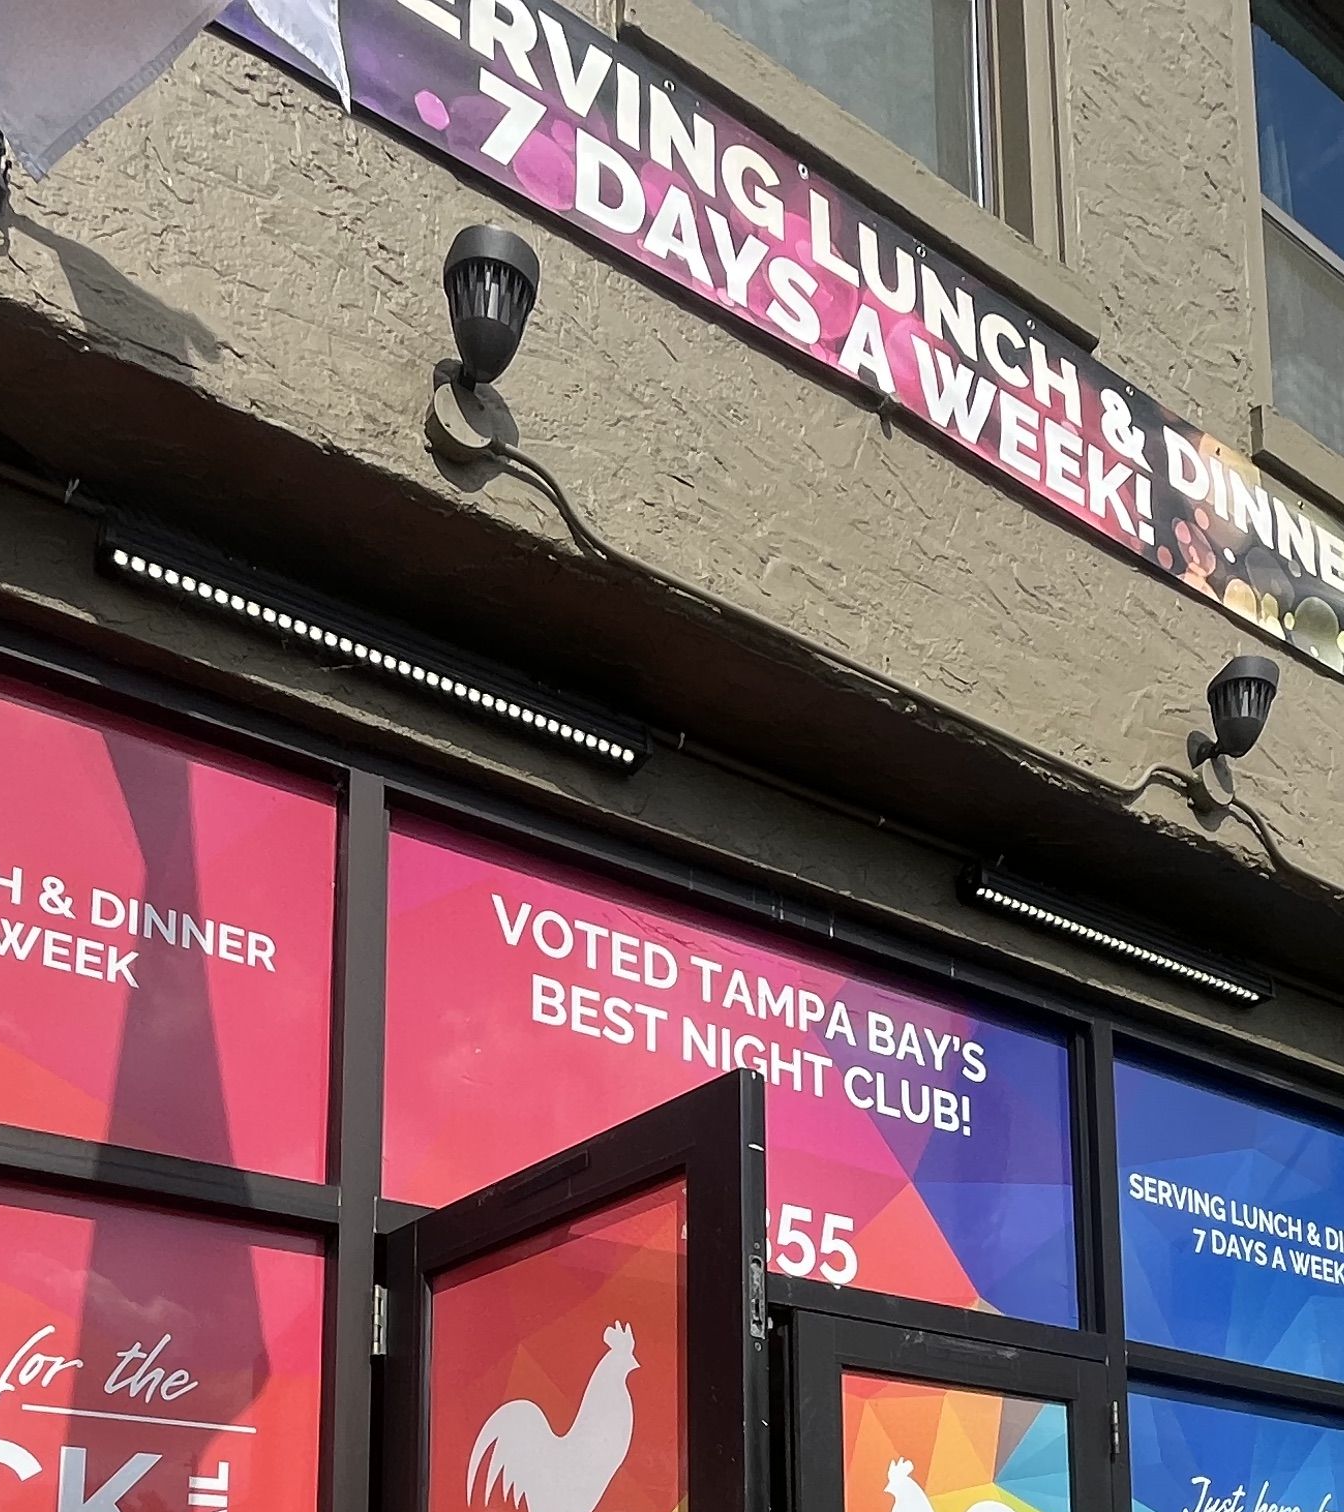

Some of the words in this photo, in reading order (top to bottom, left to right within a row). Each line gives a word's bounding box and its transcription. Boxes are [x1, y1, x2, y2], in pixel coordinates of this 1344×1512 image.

[479, 68, 548, 165] 7
[575, 127, 821, 345] DAYS
[838, 304, 895, 394] A
[911, 333, 1156, 546] WEEK!
[809, 188, 1082, 427] LUNCH
[1099, 386, 1152, 472] &
[38, 874, 75, 917] &
[91, 891, 276, 973] DINNER
[490, 894, 678, 991] VOTED
[689, 955, 856, 1048] TAMPA
[869, 1005, 988, 1084] BAY'S
[530, 973, 669, 1054] BEST
[682, 1017, 834, 1098] NIGHT
[843, 1064, 972, 1136] CLUB!
[766, 1203, 858, 1285] 55
[1129, 1172, 1226, 1222] SERVING
[1230, 1199, 1303, 1243] LUNCH
[1306, 1221, 1321, 1247] &
[1192, 1228, 1206, 1254] 7
[1210, 1232, 1268, 1267] DAYS
[1271, 1246, 1286, 1272] A
[102, 1333, 199, 1403] the
